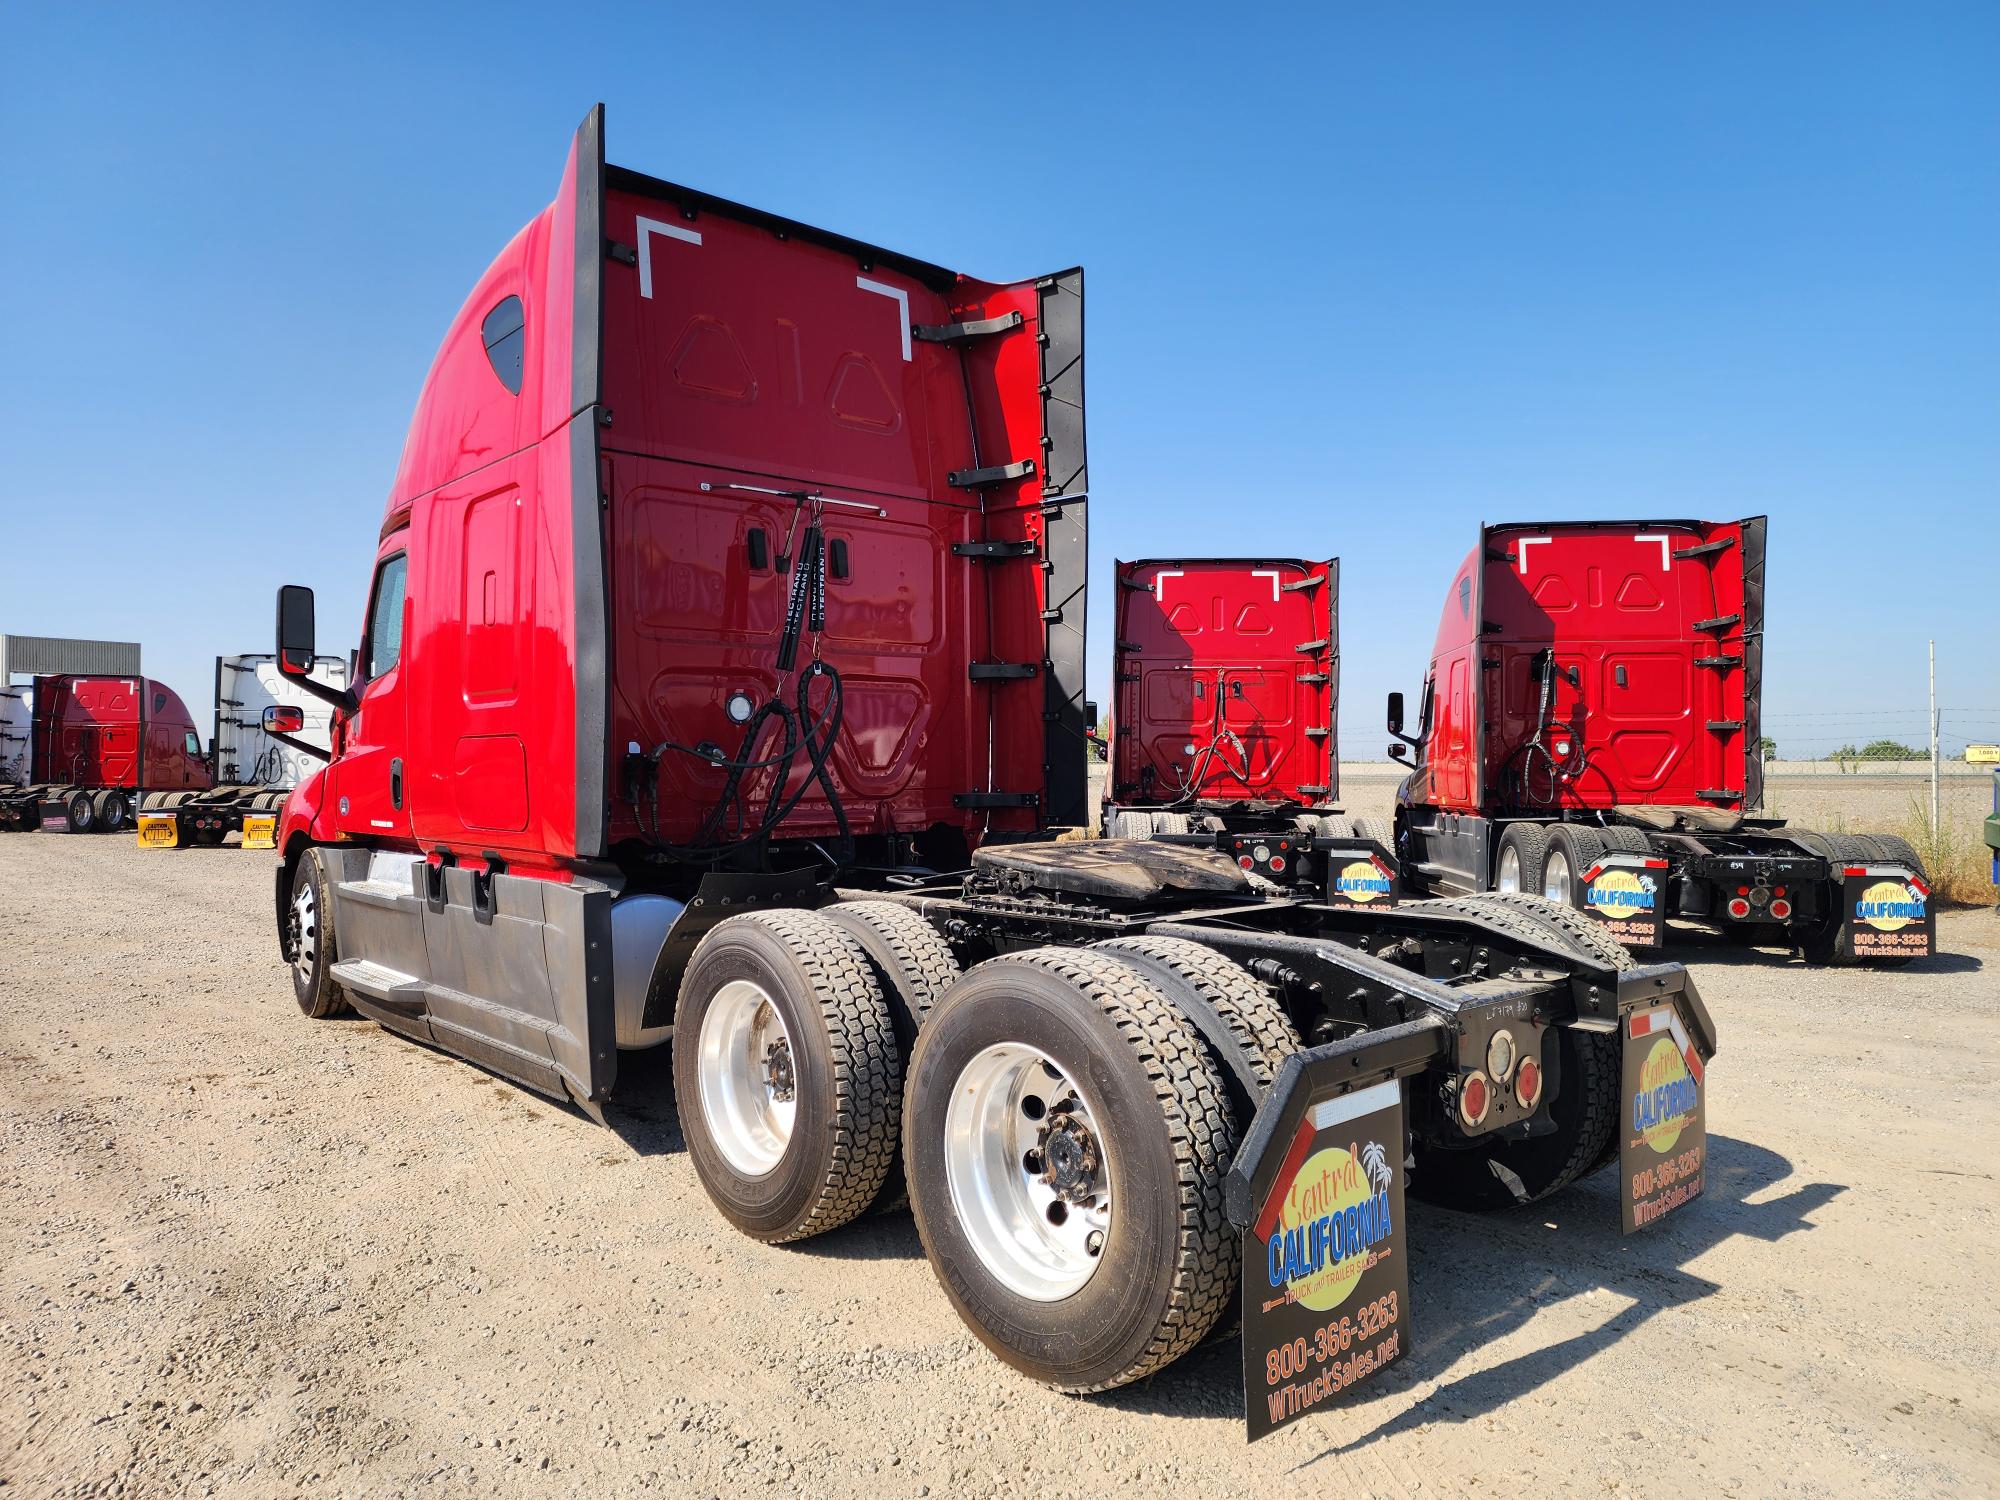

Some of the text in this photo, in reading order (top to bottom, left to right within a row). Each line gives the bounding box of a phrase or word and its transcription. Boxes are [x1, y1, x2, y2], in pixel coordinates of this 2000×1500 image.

[786, 573, 801, 622] TECTRAN
[145, 830, 171, 840] WIDE
[249, 831, 272, 840] WIDE
[1336, 877, 1391, 892] CALIFORNIA
[1587, 887, 1655, 907] CALIFORNIA
[1595, 873, 1639, 888] Central
[1862, 883, 1906, 902] Central
[1856, 901, 1926, 918] CALIFORNIA
[1853, 933, 1928, 945] 800-366-3263
[1853, 945, 1928, 956] WTruckSales.net
[1640, 1045, 1679, 1092] Central
[1634, 1075, 1697, 1131] CALIFORNIA
[1279, 1142, 1360, 1231] Central
[1633, 1147, 1700, 1199] 800-366-3263
[1633, 1175, 1700, 1226] WTruckSales.net
[1268, 1190, 1392, 1287] CALIFORNIA
[1285, 1251, 1378, 1305] TRUCK and TRAILER SALES
[1266, 1290, 1398, 1386] 800-366-3263
[1266, 1329, 1399, 1424] WTruckSales.net
